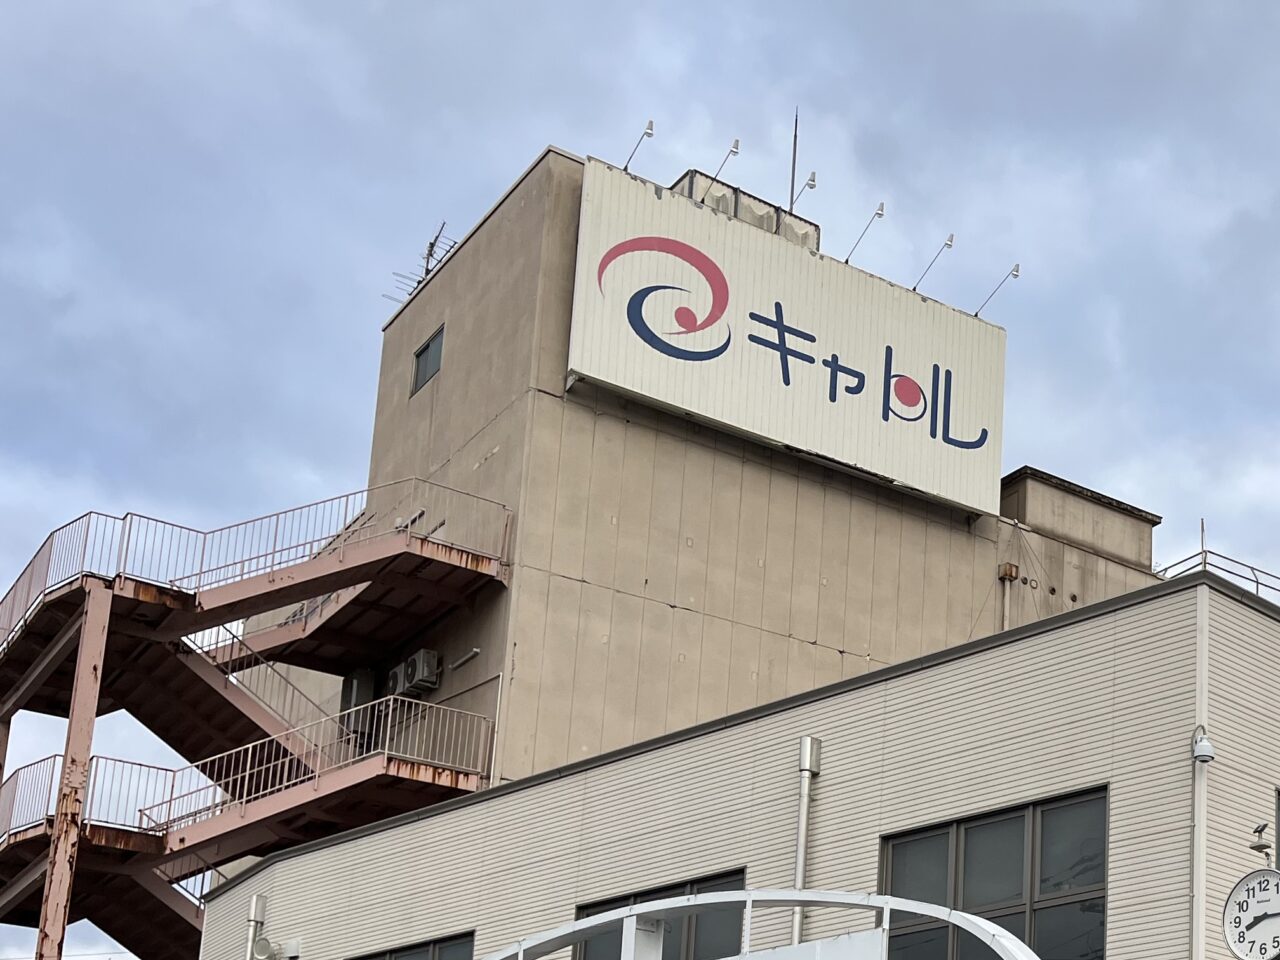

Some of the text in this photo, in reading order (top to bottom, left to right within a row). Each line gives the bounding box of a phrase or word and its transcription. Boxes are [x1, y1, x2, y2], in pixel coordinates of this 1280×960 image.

[748, 301, 988, 449] キャトル
[1257, 879, 1270, 892] 12
[1274, 881, 1279, 894] 1
[1245, 886, 1255, 899] 11
[1236, 900, 1249, 913] 10
[1233, 916, 1241, 928] 9
[1238, 931, 1245, 943] 8
[1272, 936, 1280, 949] 5
[1248, 940, 1256, 953] 7
[1259, 943, 1267, 955] 6
